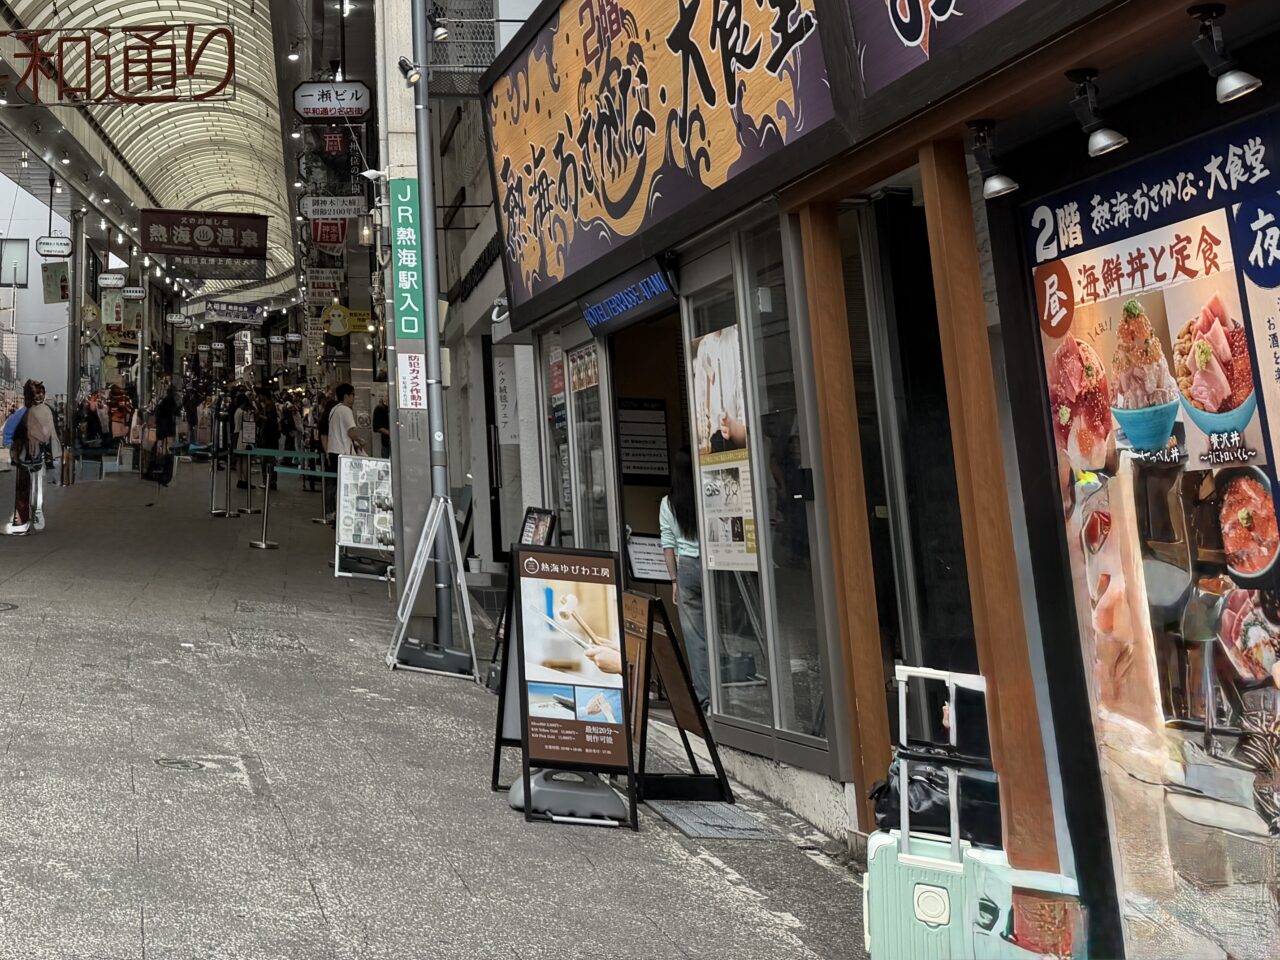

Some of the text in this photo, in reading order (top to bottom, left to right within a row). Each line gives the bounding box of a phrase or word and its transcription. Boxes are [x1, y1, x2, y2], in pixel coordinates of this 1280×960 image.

[300, 89, 364, 103] 一瀬ビル
[396, 184, 420, 333] JR熱海駅入口
[1031, 201, 1084, 263] 2階
[1076, 225, 1222, 305] 海鮮丼と定食
[1042, 272, 1068, 328] 昼
[408, 355, 422, 408] 防犯カメラ作動中
[540, 562, 611, 578] 熱海ゆびわ工房
